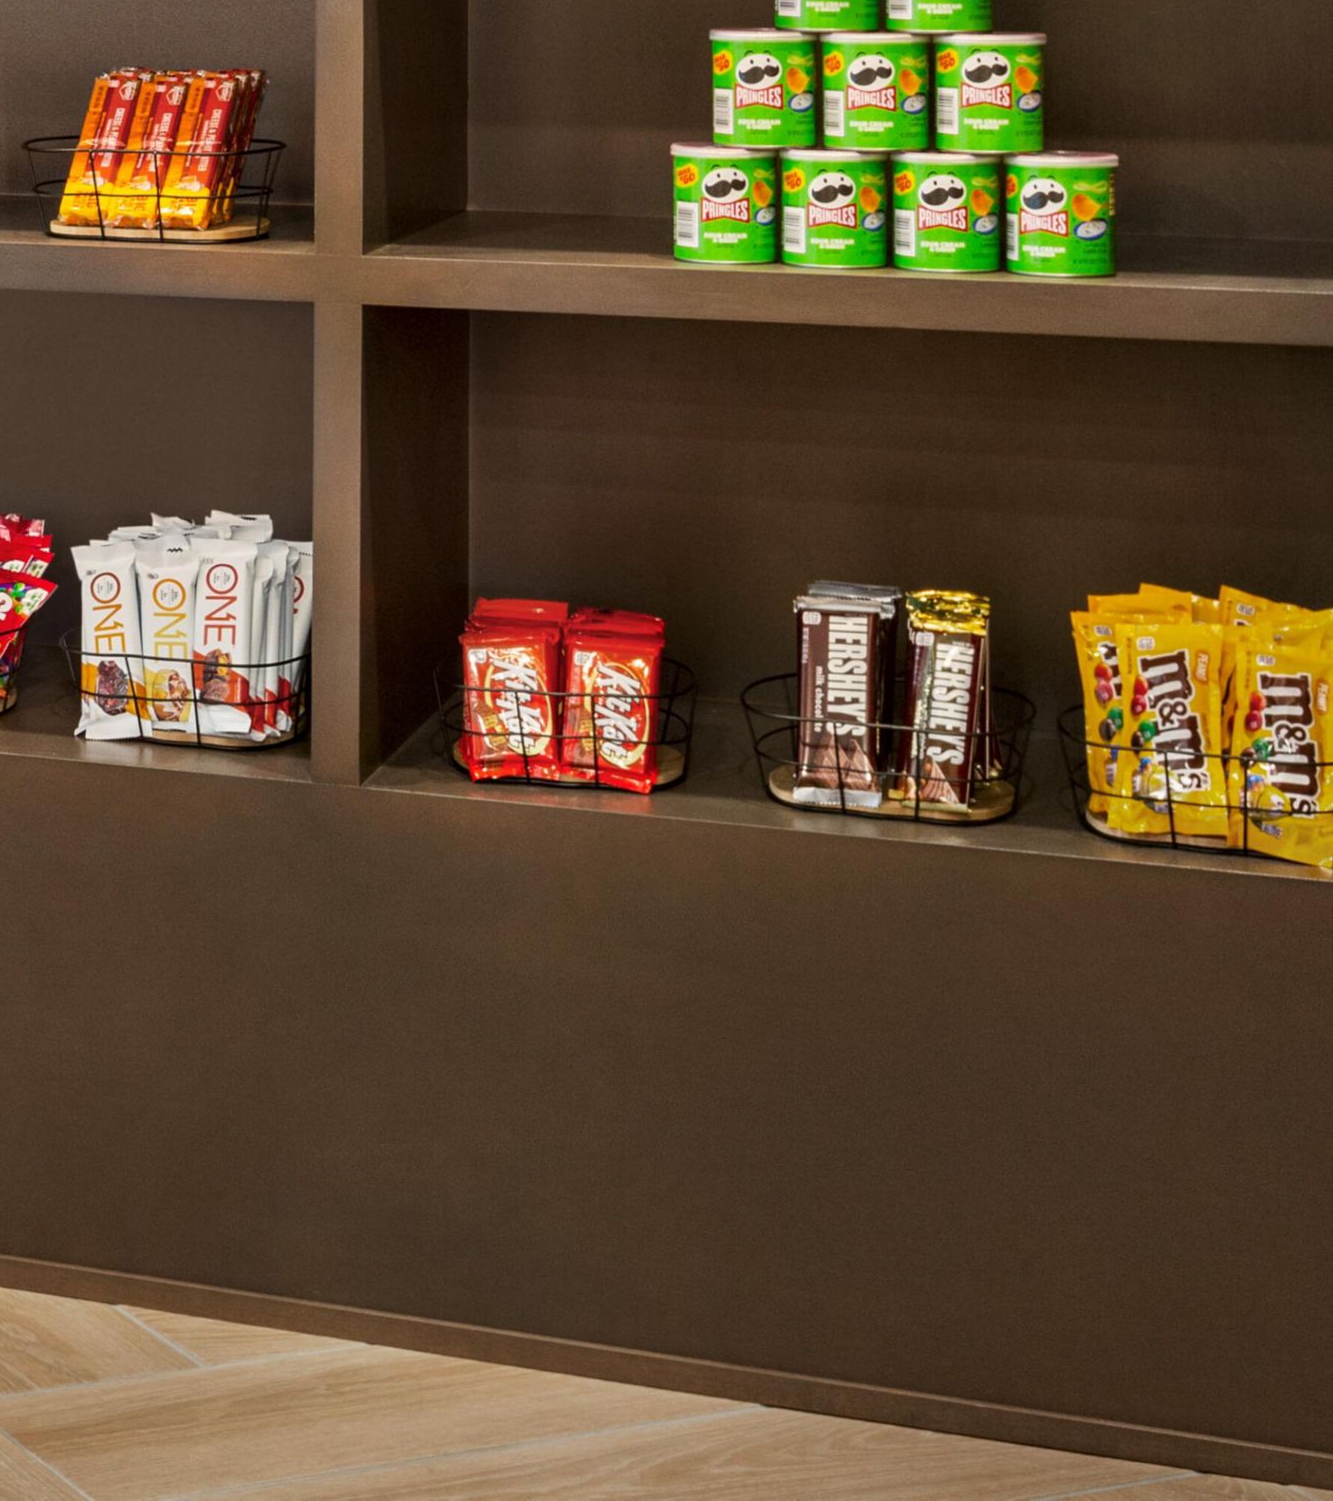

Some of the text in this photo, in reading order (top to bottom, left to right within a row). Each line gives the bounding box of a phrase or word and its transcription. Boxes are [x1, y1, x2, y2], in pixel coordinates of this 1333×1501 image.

[735, 85, 782, 108] PRINGLES
[847, 86, 896, 110] PRINGLES
[960, 85, 1011, 108] PRINGLES
[701, 198, 749, 222] PRINGLES
[807, 203, 856, 228] PRINGLES
[917, 205, 967, 230] PRINGLES
[1020, 211, 1068, 236] PRINGLES
[90, 571, 126, 655] ONE
[152, 578, 188, 660] ONE
[202, 563, 239, 646] ONE
[491, 652, 538, 703] Kit
[826, 615, 869, 737] HERSHEY'S
[1196, 653, 1209, 682] PEANUT
[594, 661, 642, 761] Kit Kat
[813, 665, 824, 733] milk chocolte
[926, 642, 975, 766] HERSHEY'S
[1317, 680, 1330, 711] PEANUT
